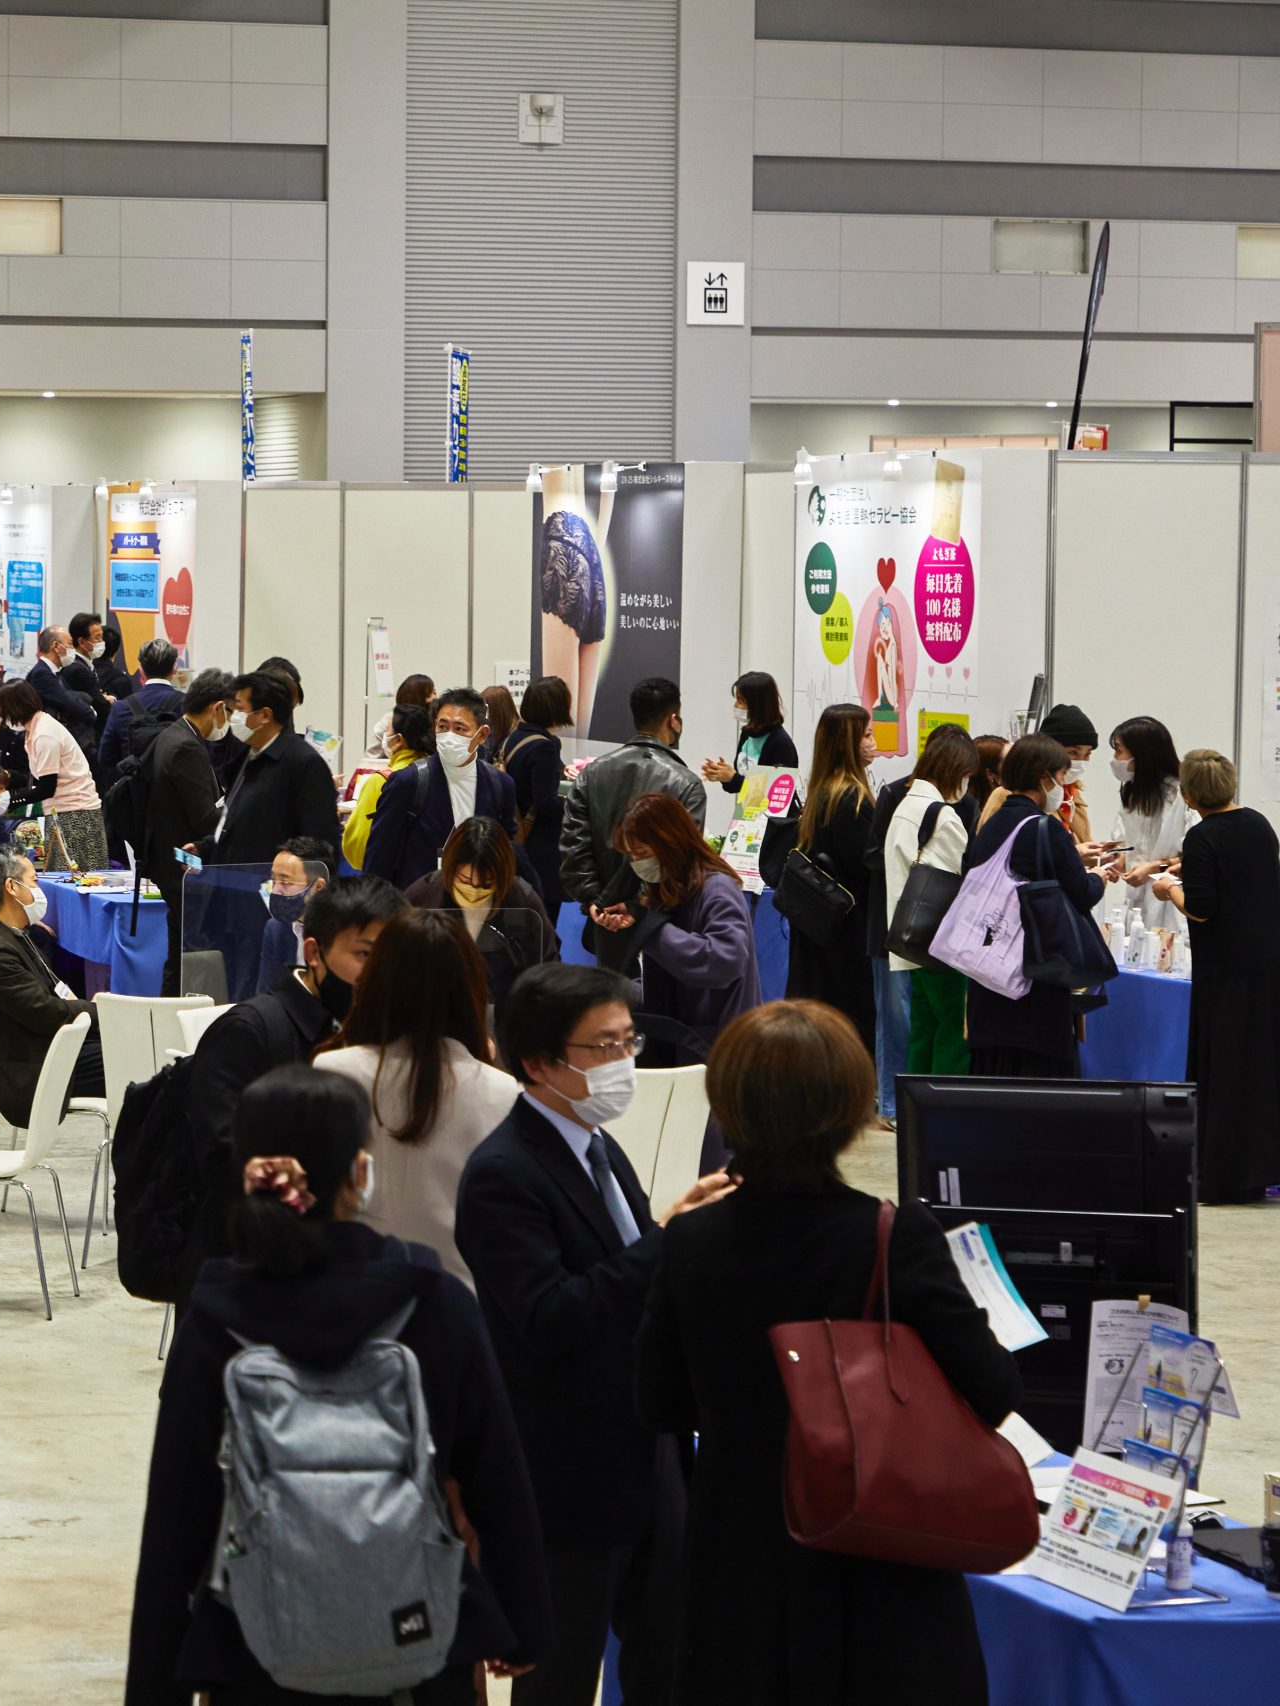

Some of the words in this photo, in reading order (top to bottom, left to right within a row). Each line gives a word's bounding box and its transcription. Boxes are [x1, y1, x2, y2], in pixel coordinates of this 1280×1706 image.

[932, 547, 957, 561] よもぎ茶
[926, 573, 963, 594] 毎日先着
[620, 593, 673, 608] 温めながら美しい
[926, 599, 941, 616] 100
[942, 597, 961, 618] 名様
[620, 614, 680, 631] 美しいのに心地いい
[926, 621, 963, 642] 無料配布
